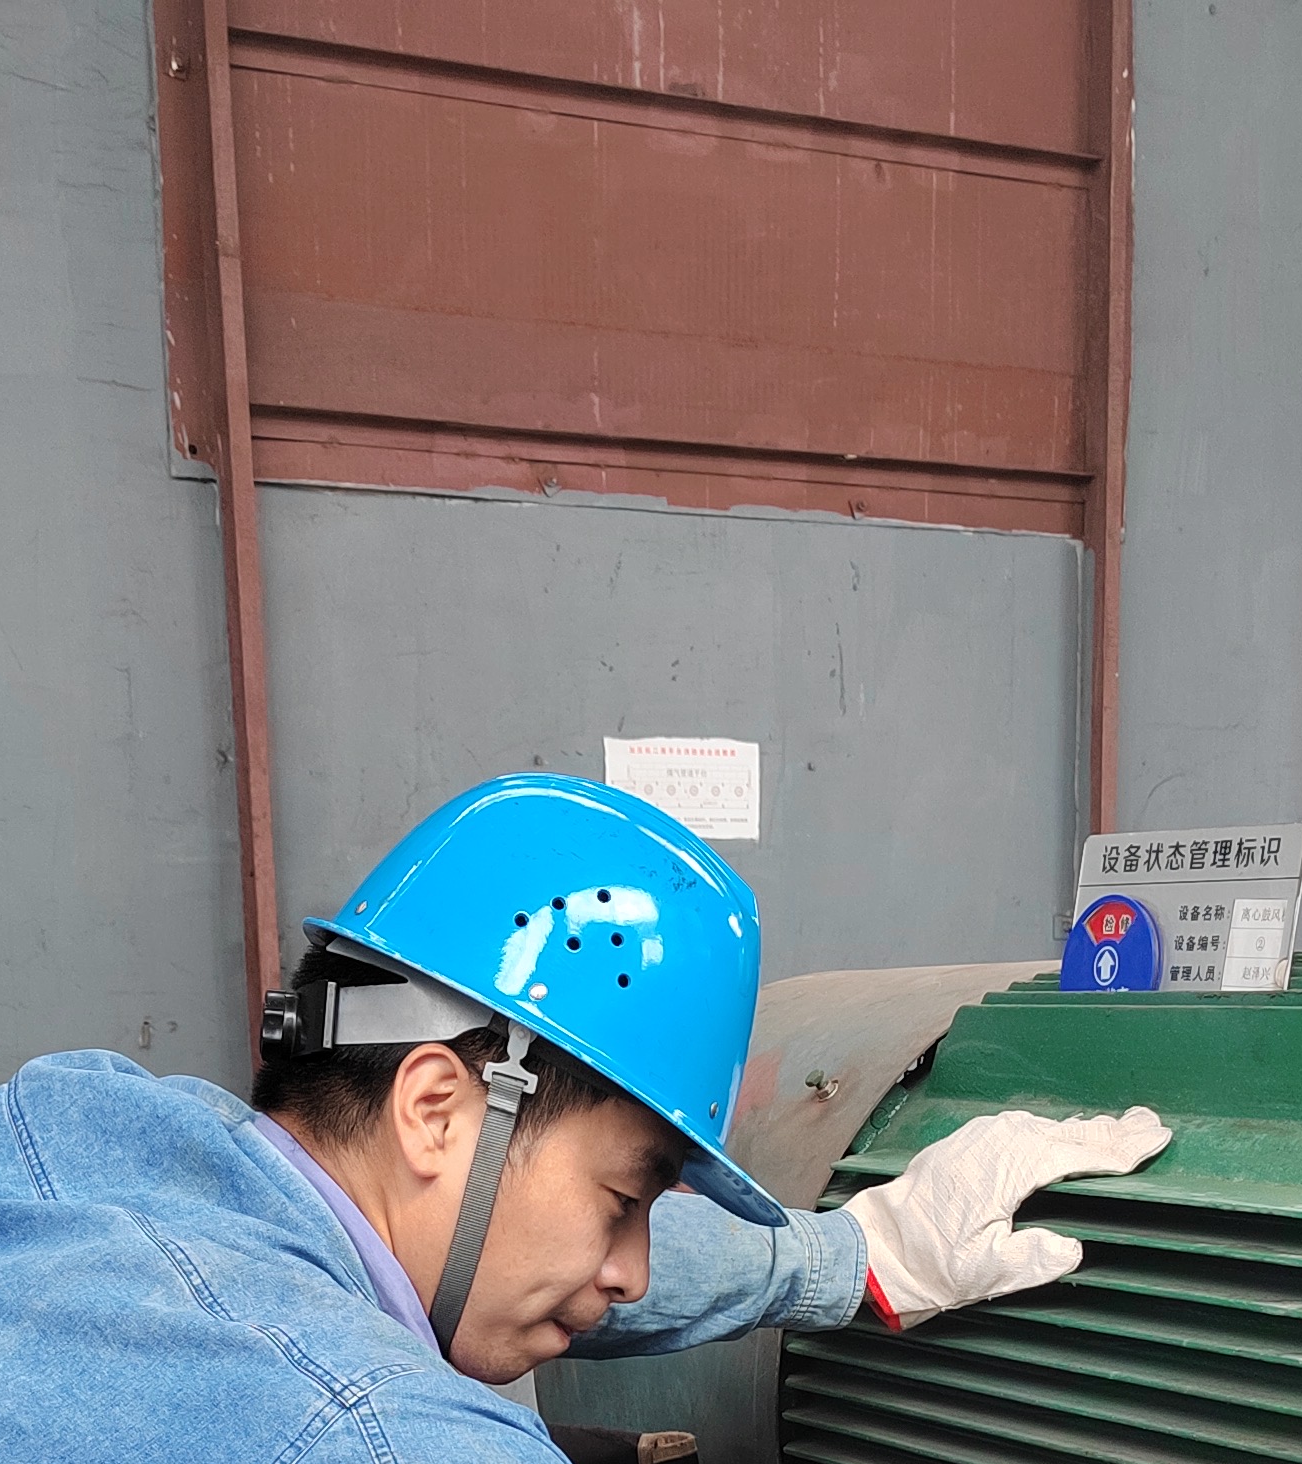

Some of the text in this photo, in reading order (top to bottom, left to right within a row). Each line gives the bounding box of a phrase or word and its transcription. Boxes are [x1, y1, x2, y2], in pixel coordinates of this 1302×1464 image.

[1101, 836, 1282, 874] 设备状态管理标识
